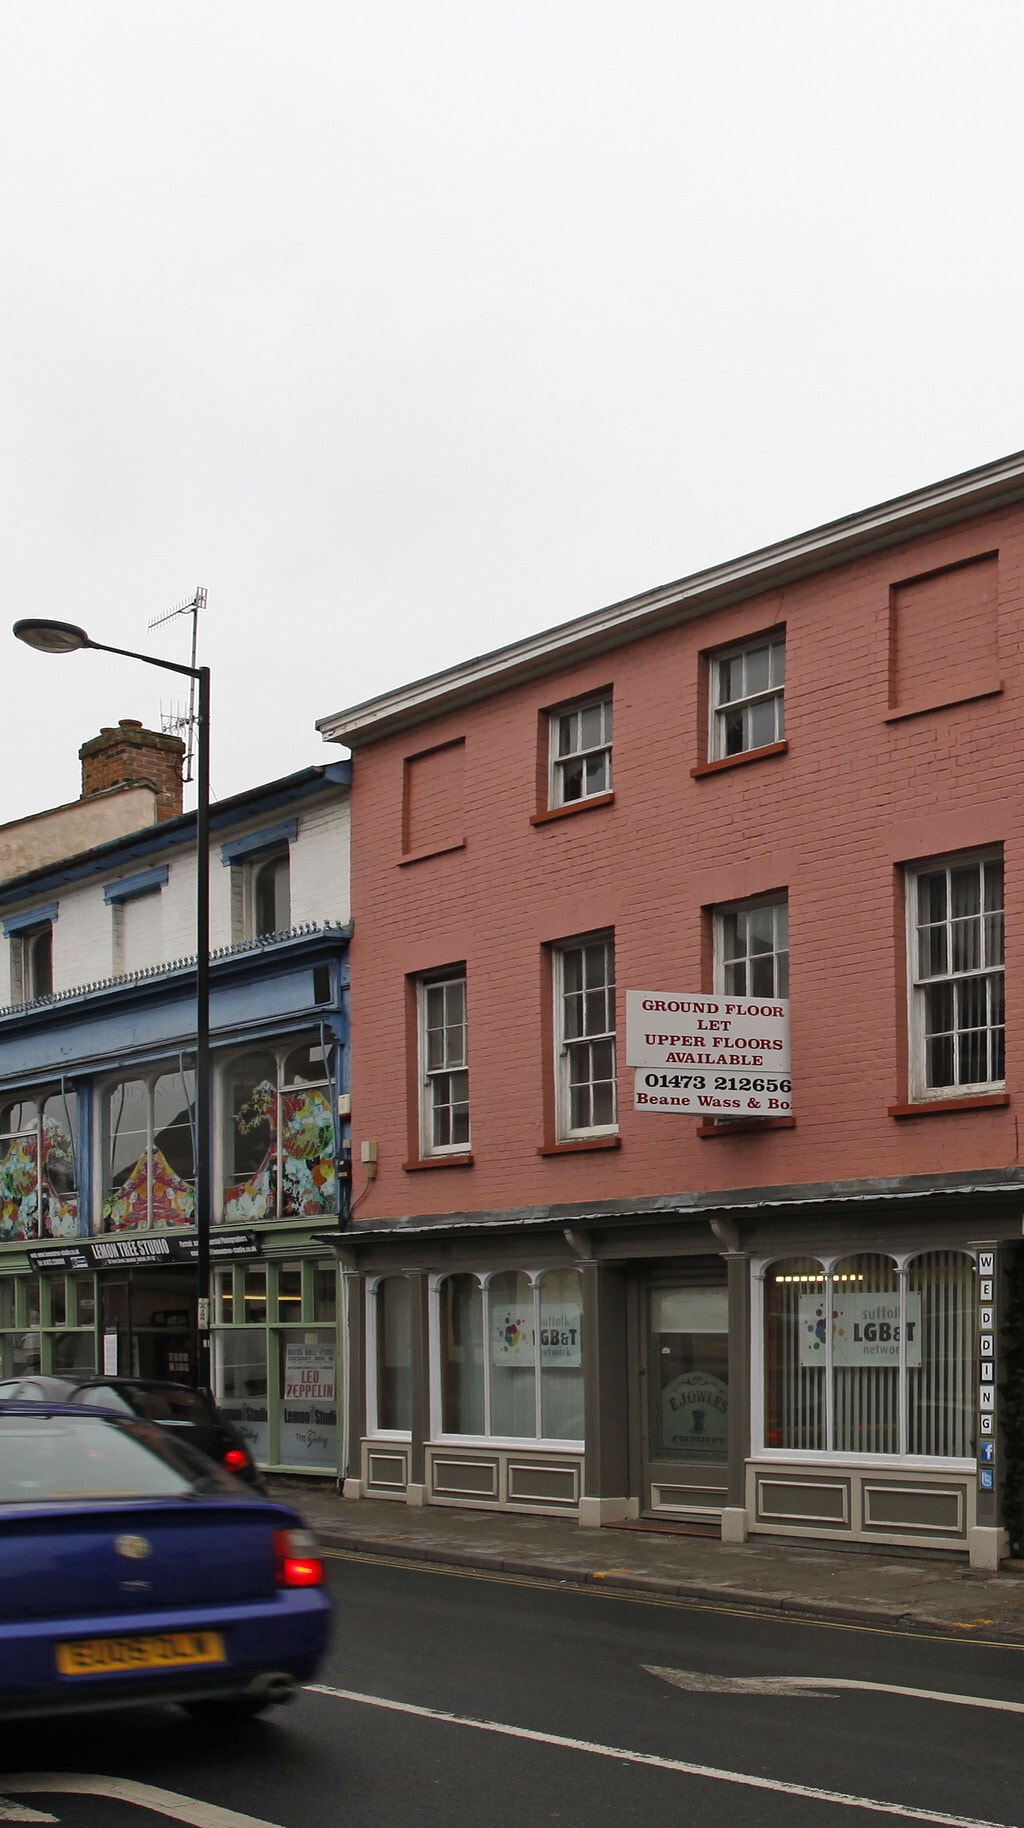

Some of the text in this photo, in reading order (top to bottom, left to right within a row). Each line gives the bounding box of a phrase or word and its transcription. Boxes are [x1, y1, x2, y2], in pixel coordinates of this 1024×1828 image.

[642, 999, 785, 1018] GROUND FLOOR
[697, 1020, 731, 1032] LET
[645, 1034, 783, 1050] UPPER FLOORS
[665, 1052, 763, 1066] AVAILABLE
[645, 1073, 792, 1093] 01473 212656
[636, 1092, 691, 1106] Beane
[698, 1095, 741, 1108] Wass
[747, 1098, 761, 1109] &
[91, 1242, 119, 1260] LEMON
[118, 1240, 139, 1258] TREE
[138, 1238, 170, 1256] STUDIO
[863, 1345, 900, 1355] networ
[301, 1370, 320, 1384] LED
[286, 1384, 334, 1398] ZEPPELIN
[284, 1407, 310, 1424] Lemon
